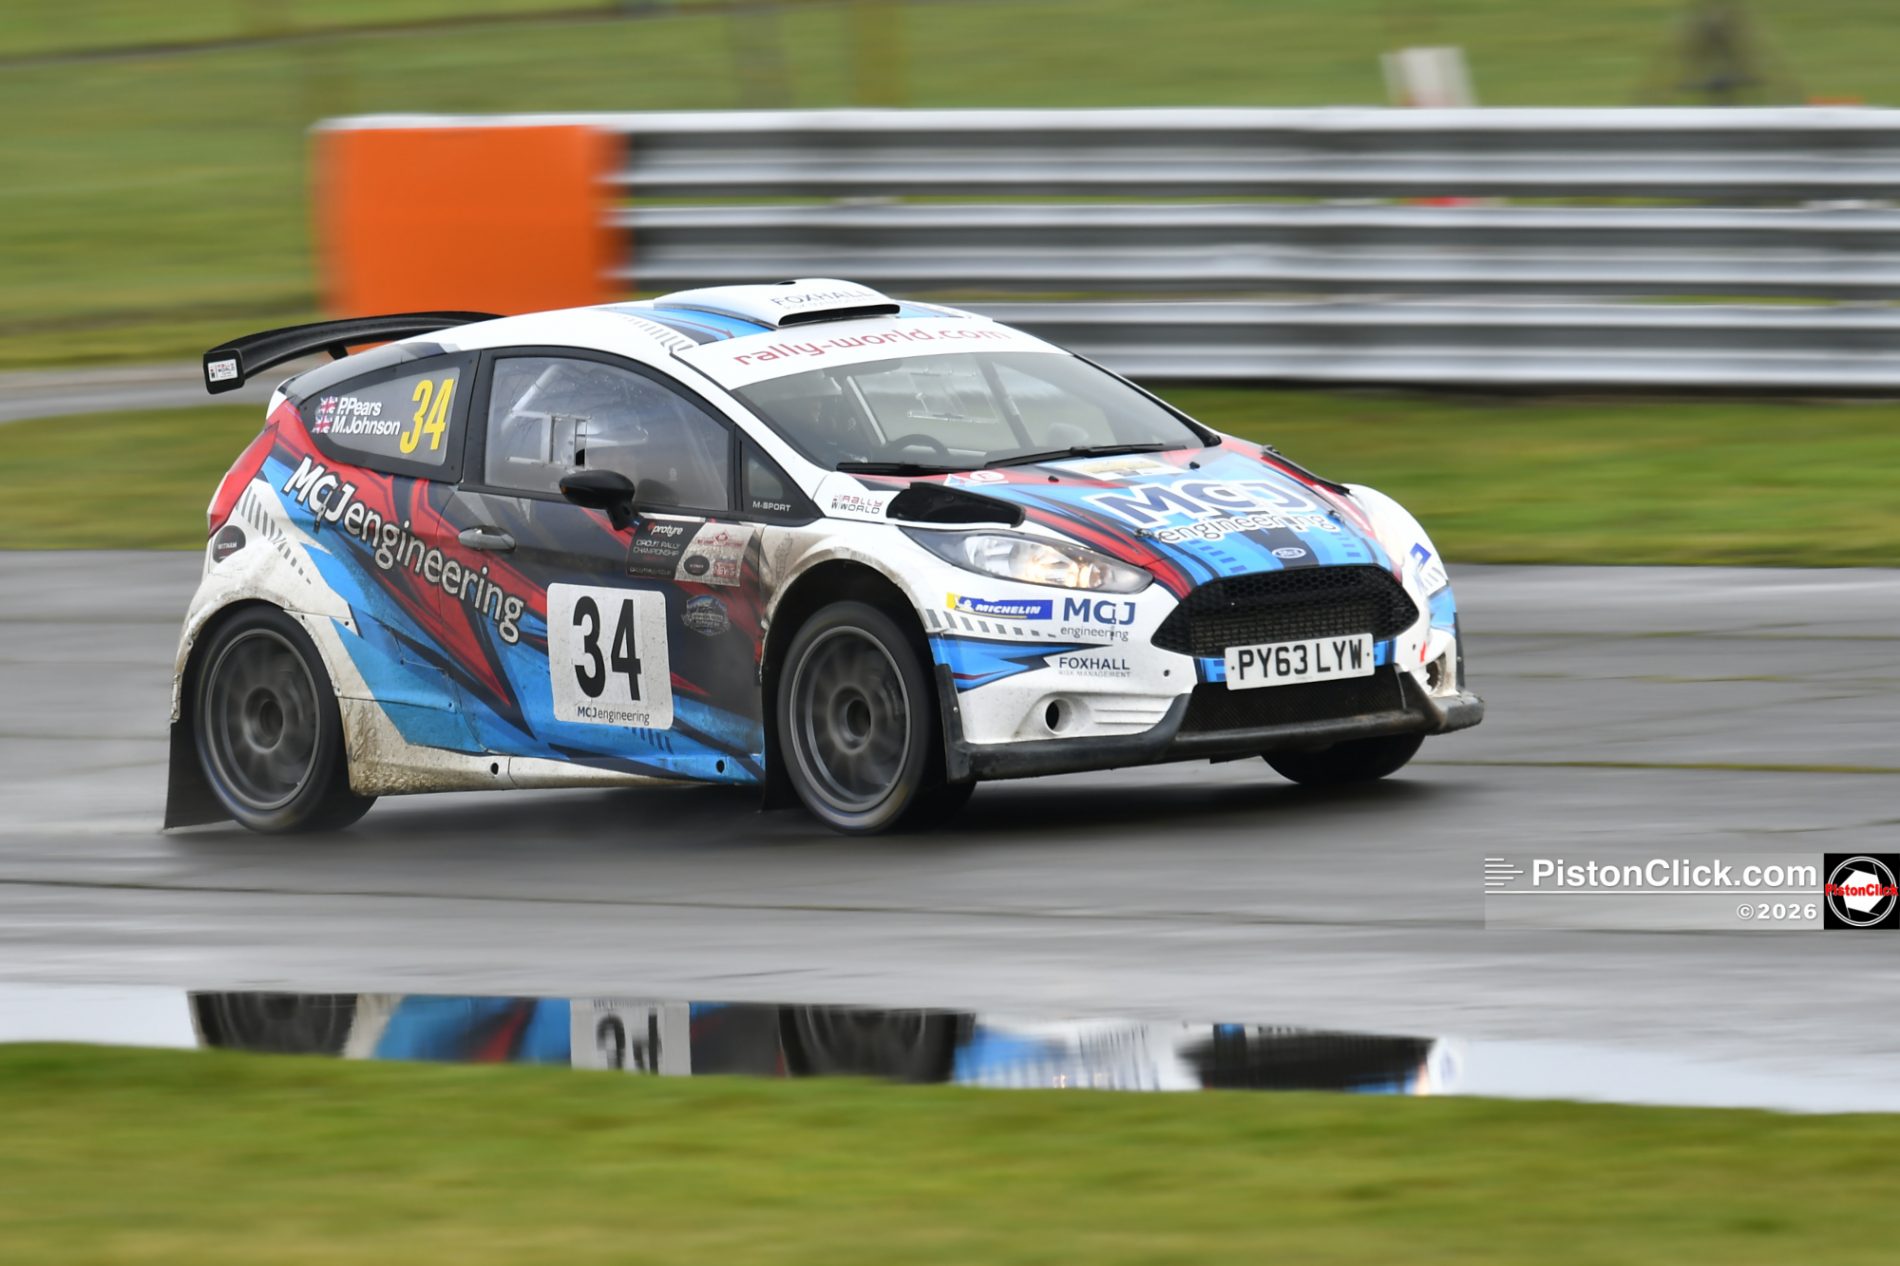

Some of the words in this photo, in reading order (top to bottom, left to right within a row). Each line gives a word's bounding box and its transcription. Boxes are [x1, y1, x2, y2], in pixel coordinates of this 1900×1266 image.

[770, 288, 874, 306] FOXHALL
[734, 328, 1011, 365] rally-world.com
[337, 397, 382, 416] P.Pears
[400, 378, 455, 454] 34
[331, 415, 401, 435] M.Johnson
[752, 501, 791, 512] M-SPORT
[651, 525, 683, 537] protyre
[975, 604, 1042, 615] MICHELIN
[1063, 597, 1136, 626] MCJ
[1060, 626, 1129, 642] engineering
[573, 595, 642, 702] 34
[1059, 657, 1131, 671] FOXHALL
[1238, 644, 1308, 681] PY63
[1316, 638, 1363, 674] LYW
